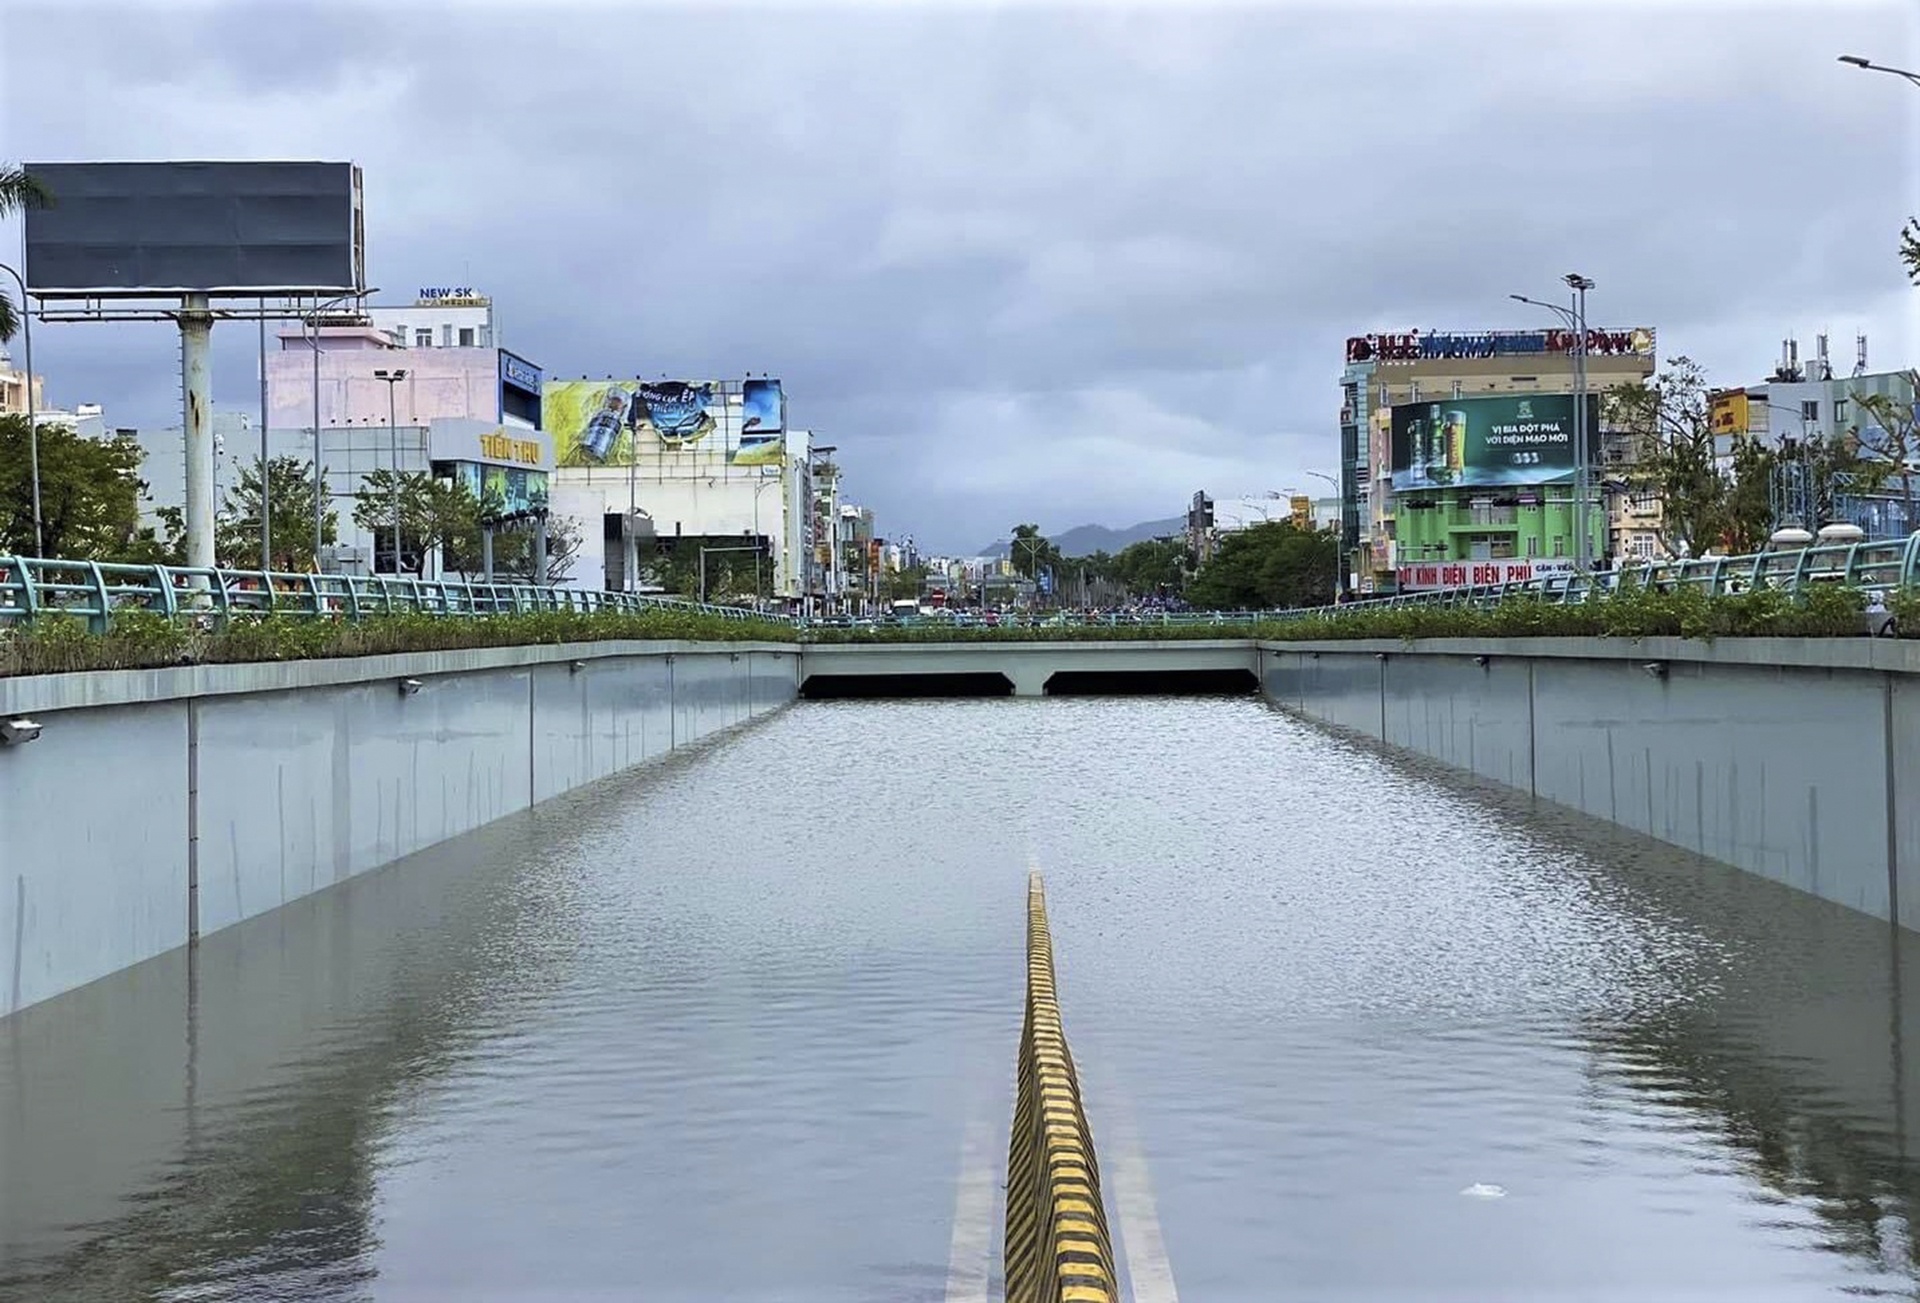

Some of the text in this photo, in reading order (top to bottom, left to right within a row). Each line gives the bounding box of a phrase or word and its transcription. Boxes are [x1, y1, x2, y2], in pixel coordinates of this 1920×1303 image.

[420, 288, 472, 298] NEW SK
[1503, 425, 1518, 434] BIA
[1541, 421, 1560, 432] PHÁ
[1549, 432, 1568, 442] MỚI
[513, 440, 538, 464] THU
[1443, 562, 1466, 588] ĐIỆN
[1473, 563, 1500, 585] BIÊN
[1507, 559, 1532, 582] PHỦ
